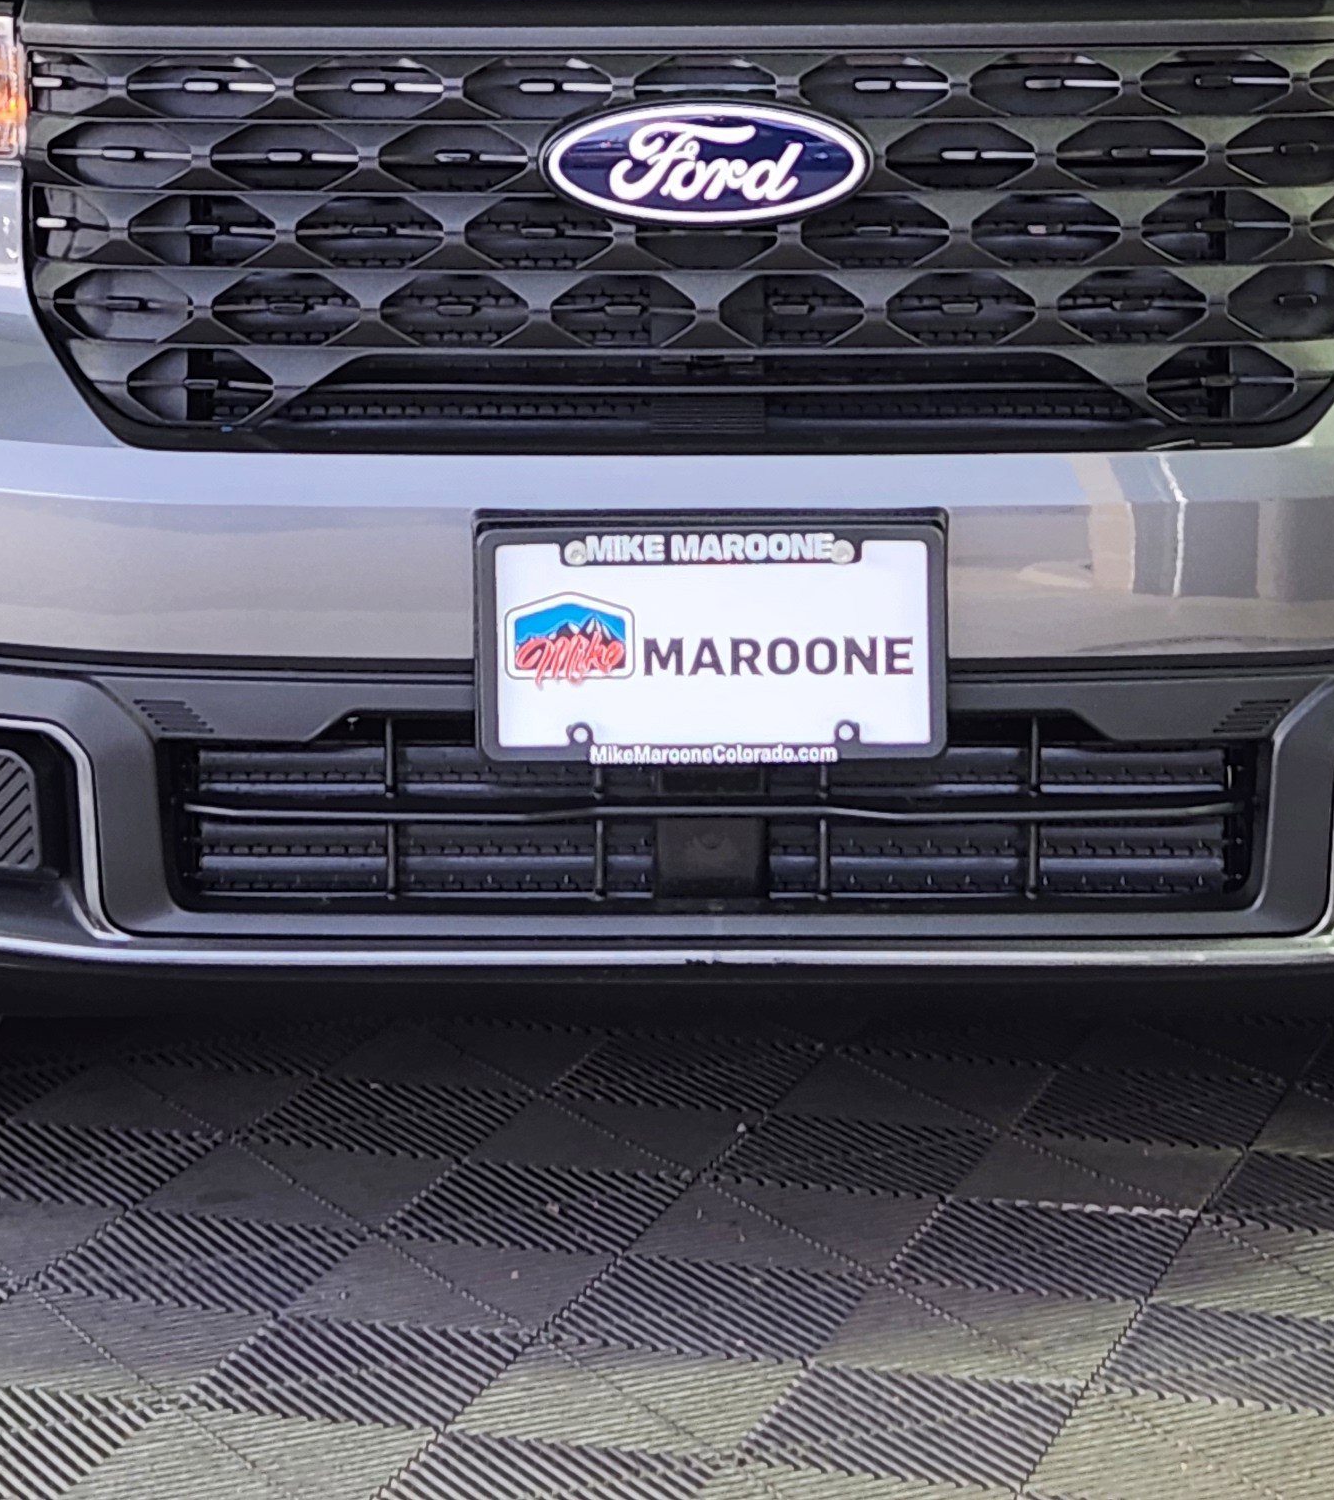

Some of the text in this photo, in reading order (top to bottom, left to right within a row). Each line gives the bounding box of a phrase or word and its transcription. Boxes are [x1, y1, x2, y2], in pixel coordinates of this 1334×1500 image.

[609, 121, 804, 201] Ford
[585, 532, 836, 563] MIKE MAROONE
[515, 630, 915, 688] Mike MAROONE
[589, 743, 839, 766] MikeMarooneColorado.com
